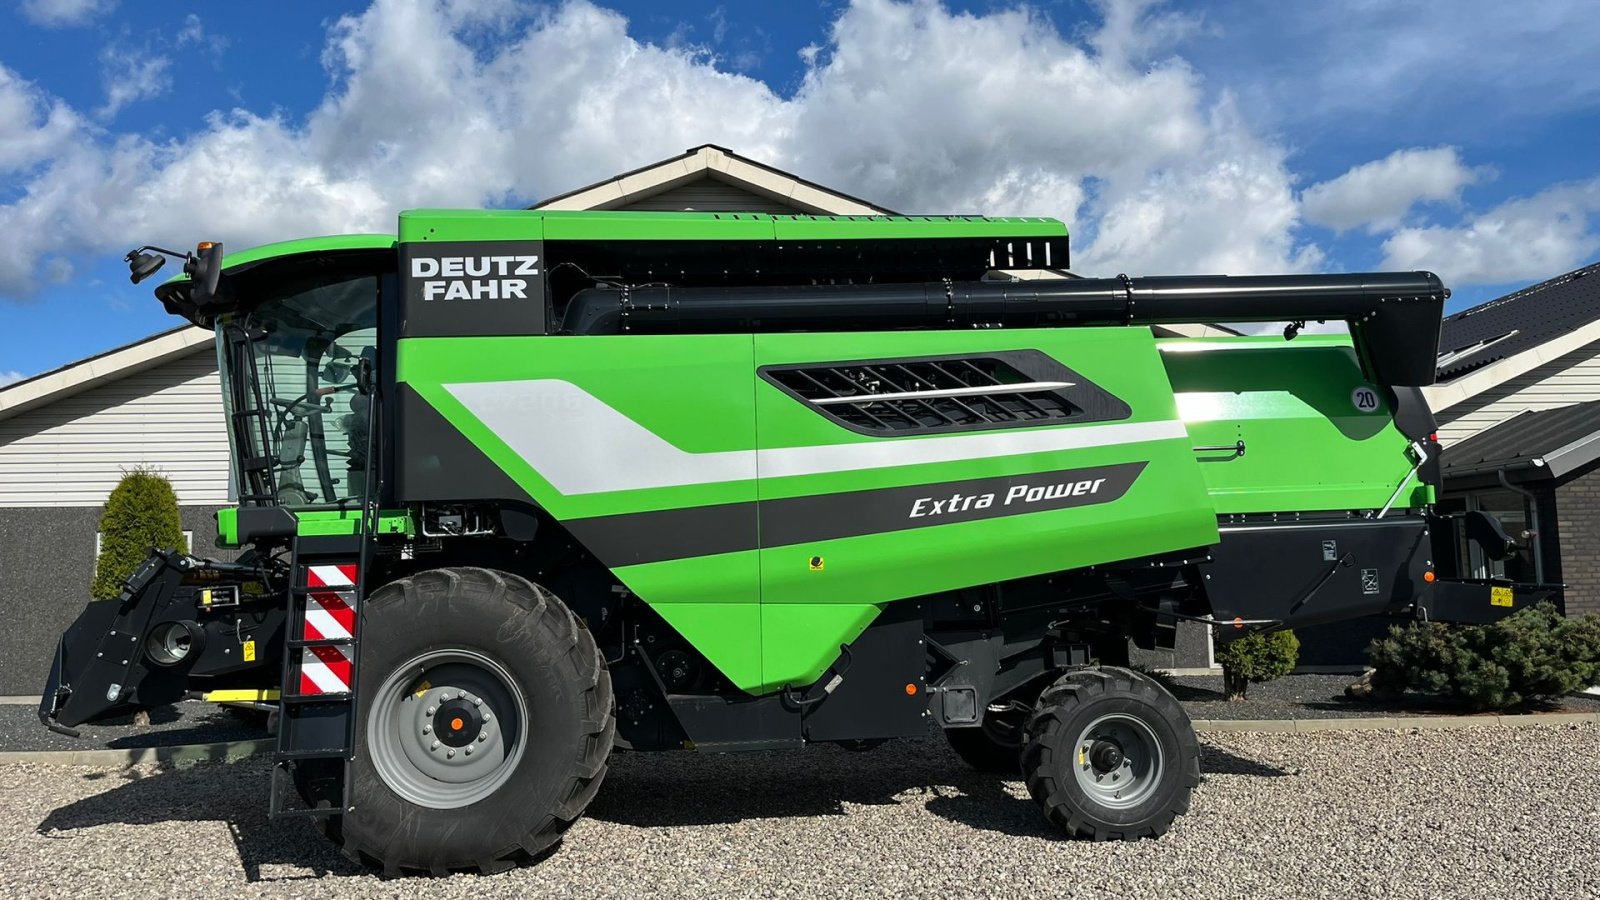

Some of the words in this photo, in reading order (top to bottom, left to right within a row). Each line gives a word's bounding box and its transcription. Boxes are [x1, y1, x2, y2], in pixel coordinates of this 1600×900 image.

[412, 256, 538, 277] DEUTZ
[424, 279, 527, 300] FAHR
[1357, 391, 1375, 408] 20
[909, 493, 995, 518] Extra
[1004, 478, 1106, 505] Power
